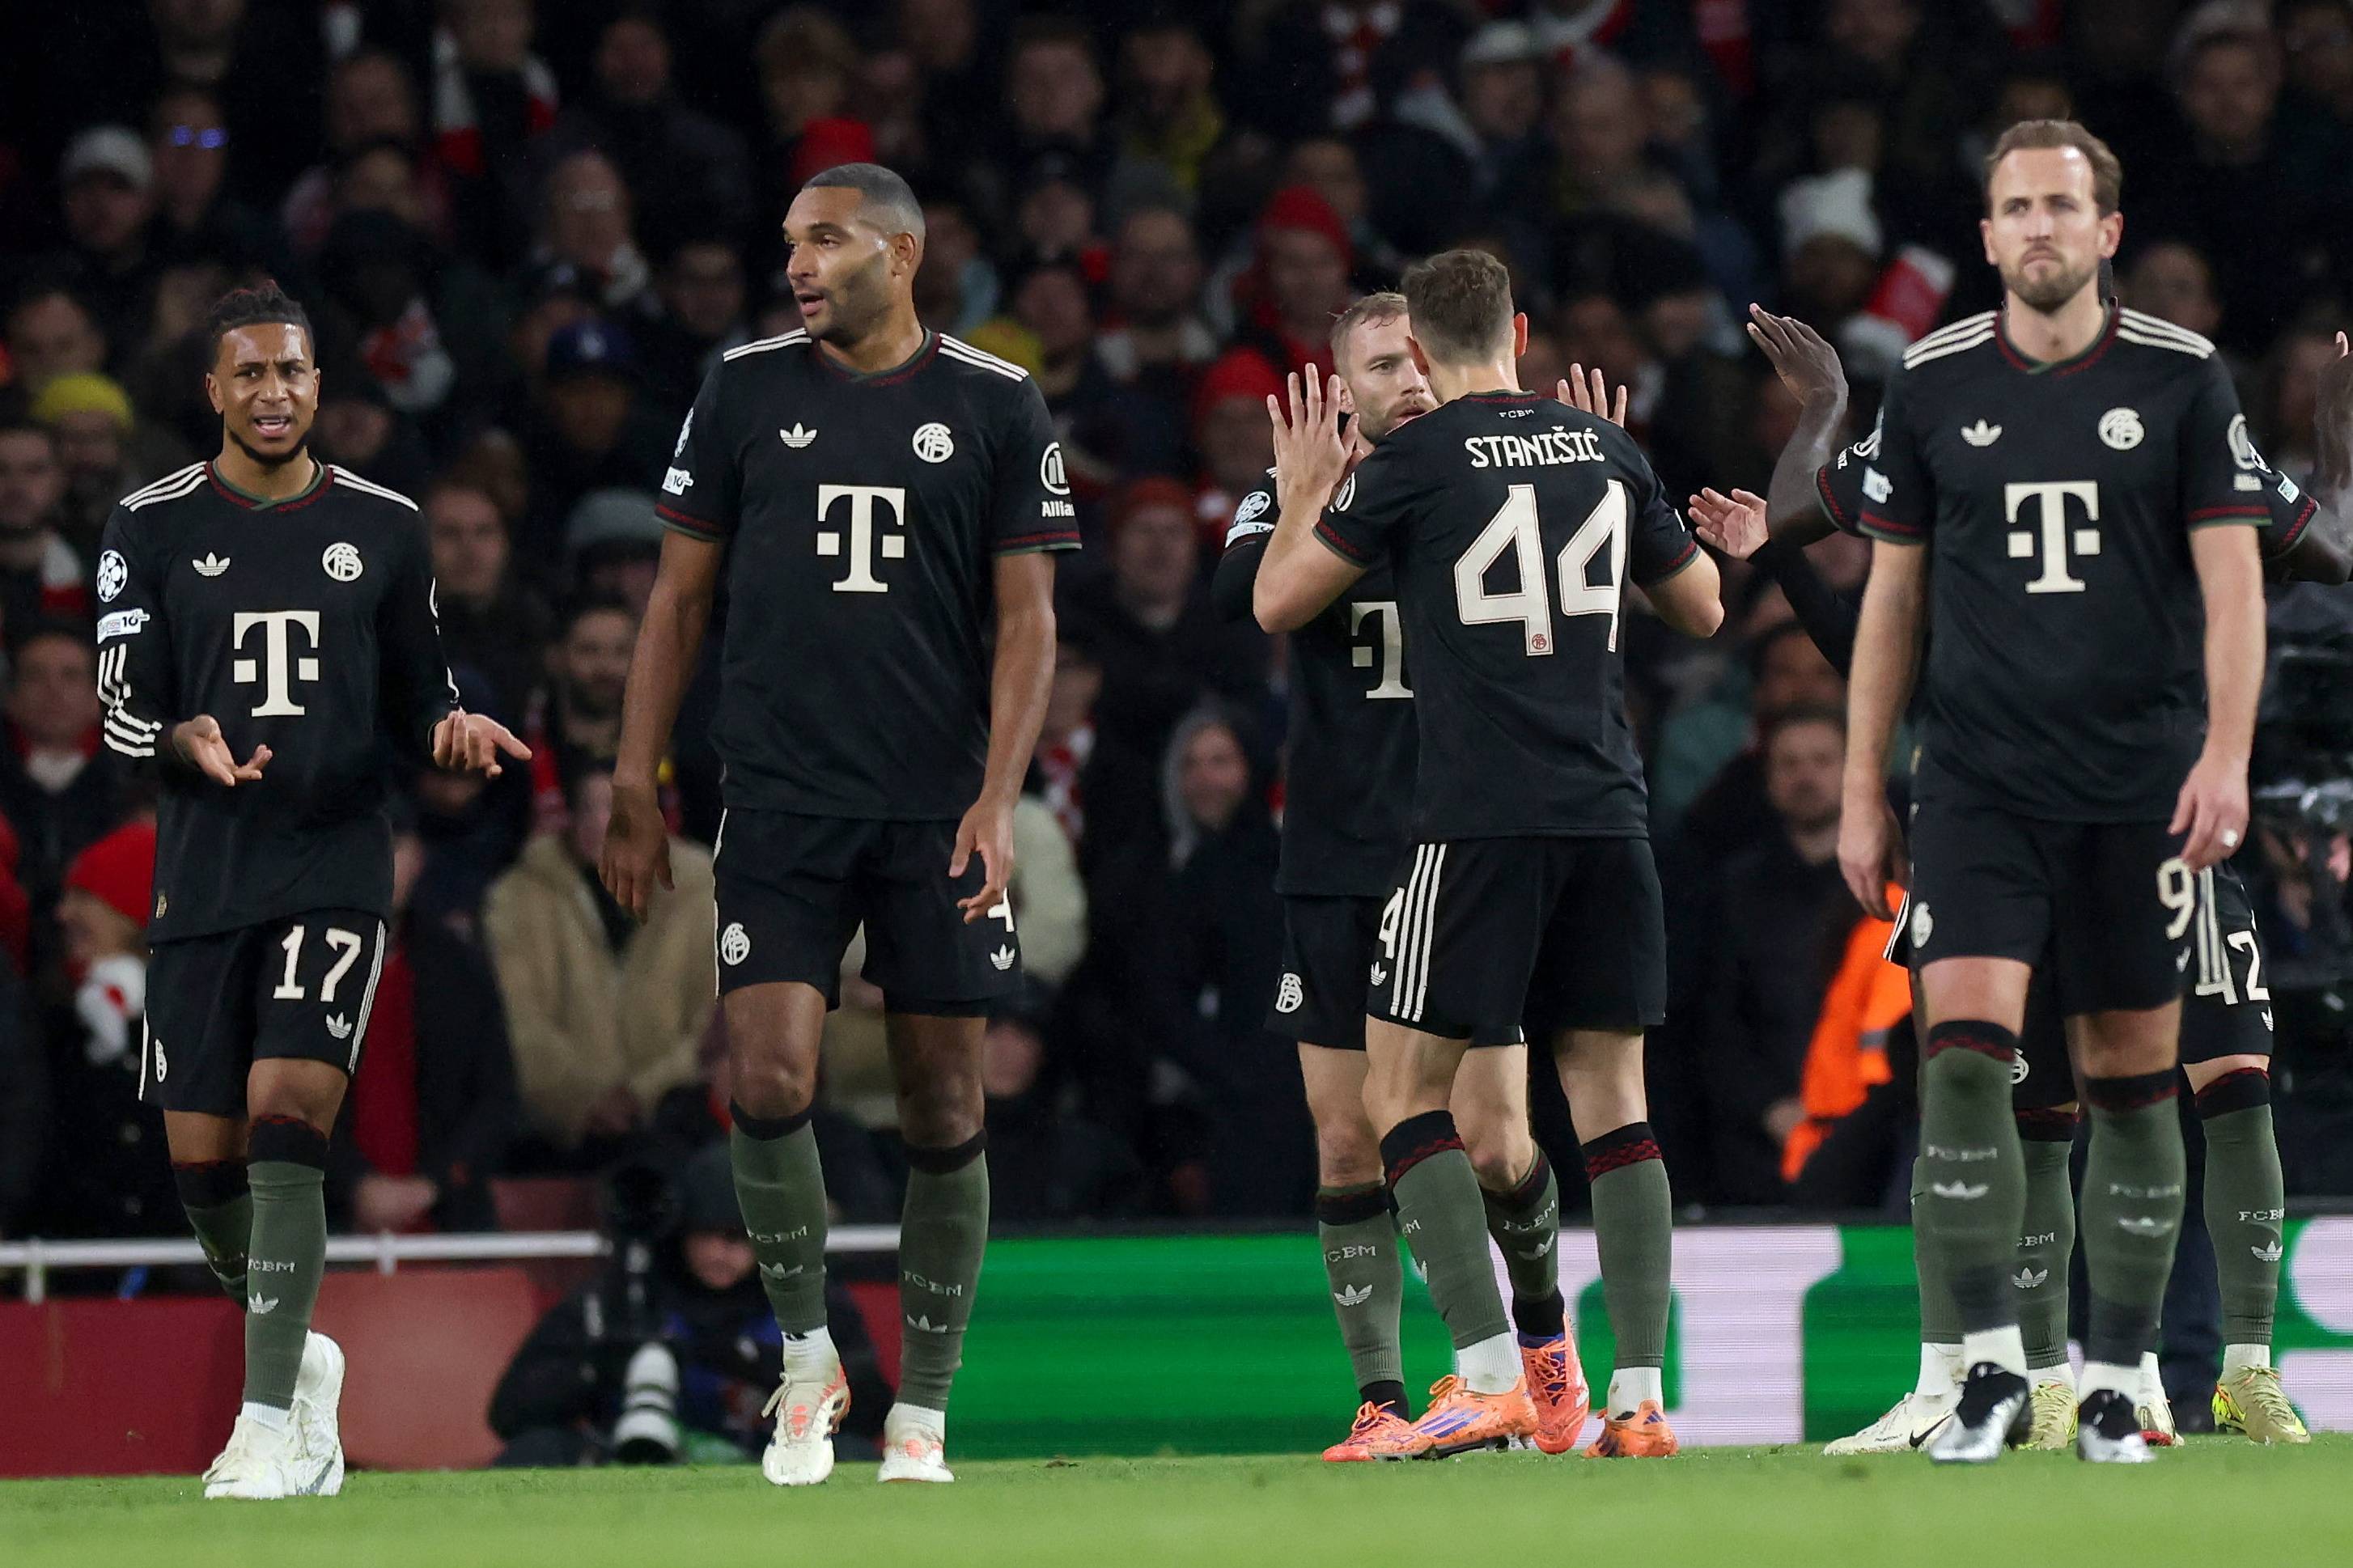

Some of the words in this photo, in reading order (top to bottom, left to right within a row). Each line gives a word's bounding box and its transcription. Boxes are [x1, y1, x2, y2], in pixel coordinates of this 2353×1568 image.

[1465, 426, 1605, 468] STANIŠIĆ
[1499, 409, 1534, 418] FCBM
[1041, 500, 1075, 518] Allia
[1454, 479, 1626, 656] 44
[1379, 887, 1405, 960] 4
[2156, 857, 2195, 939] 9
[273, 925, 361, 1002] 17
